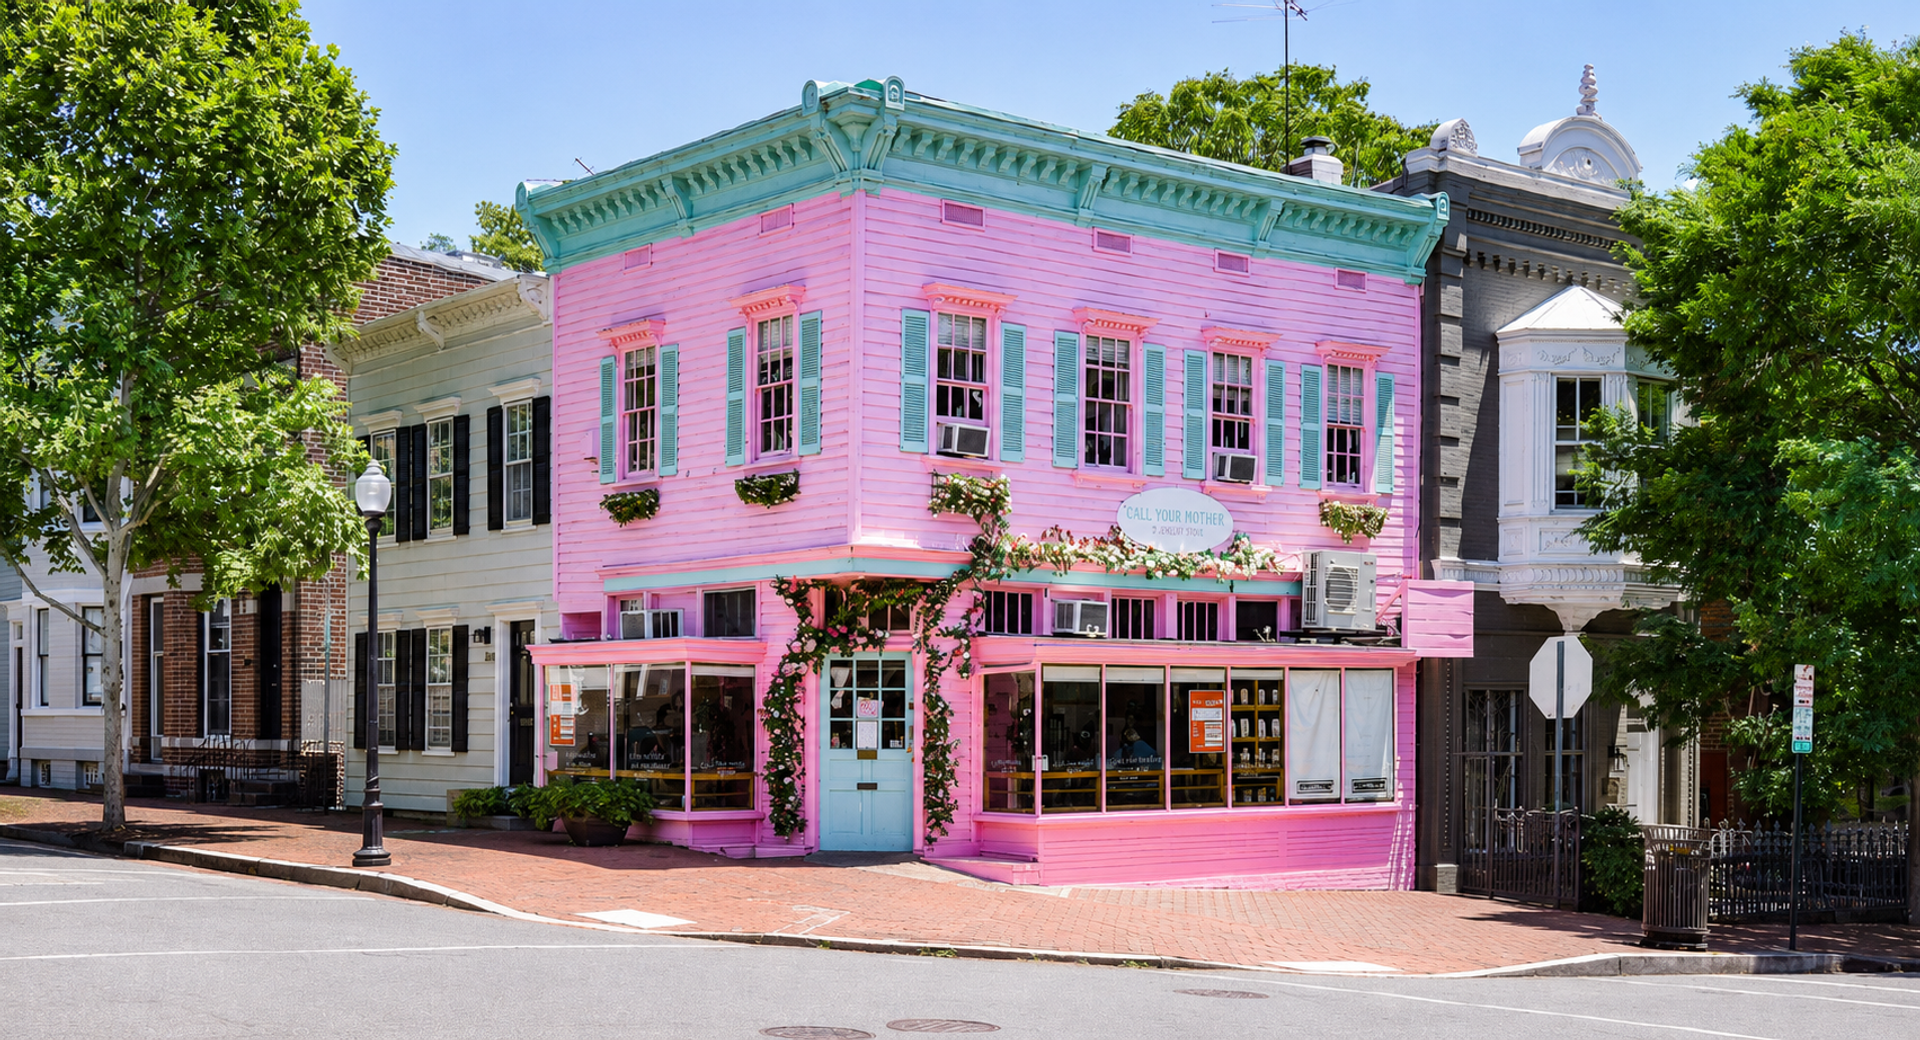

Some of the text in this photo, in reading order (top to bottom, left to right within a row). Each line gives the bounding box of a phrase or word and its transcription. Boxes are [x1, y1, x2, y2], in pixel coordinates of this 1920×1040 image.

[1126, 506, 1224, 526] CALL YOUR MOTHER
